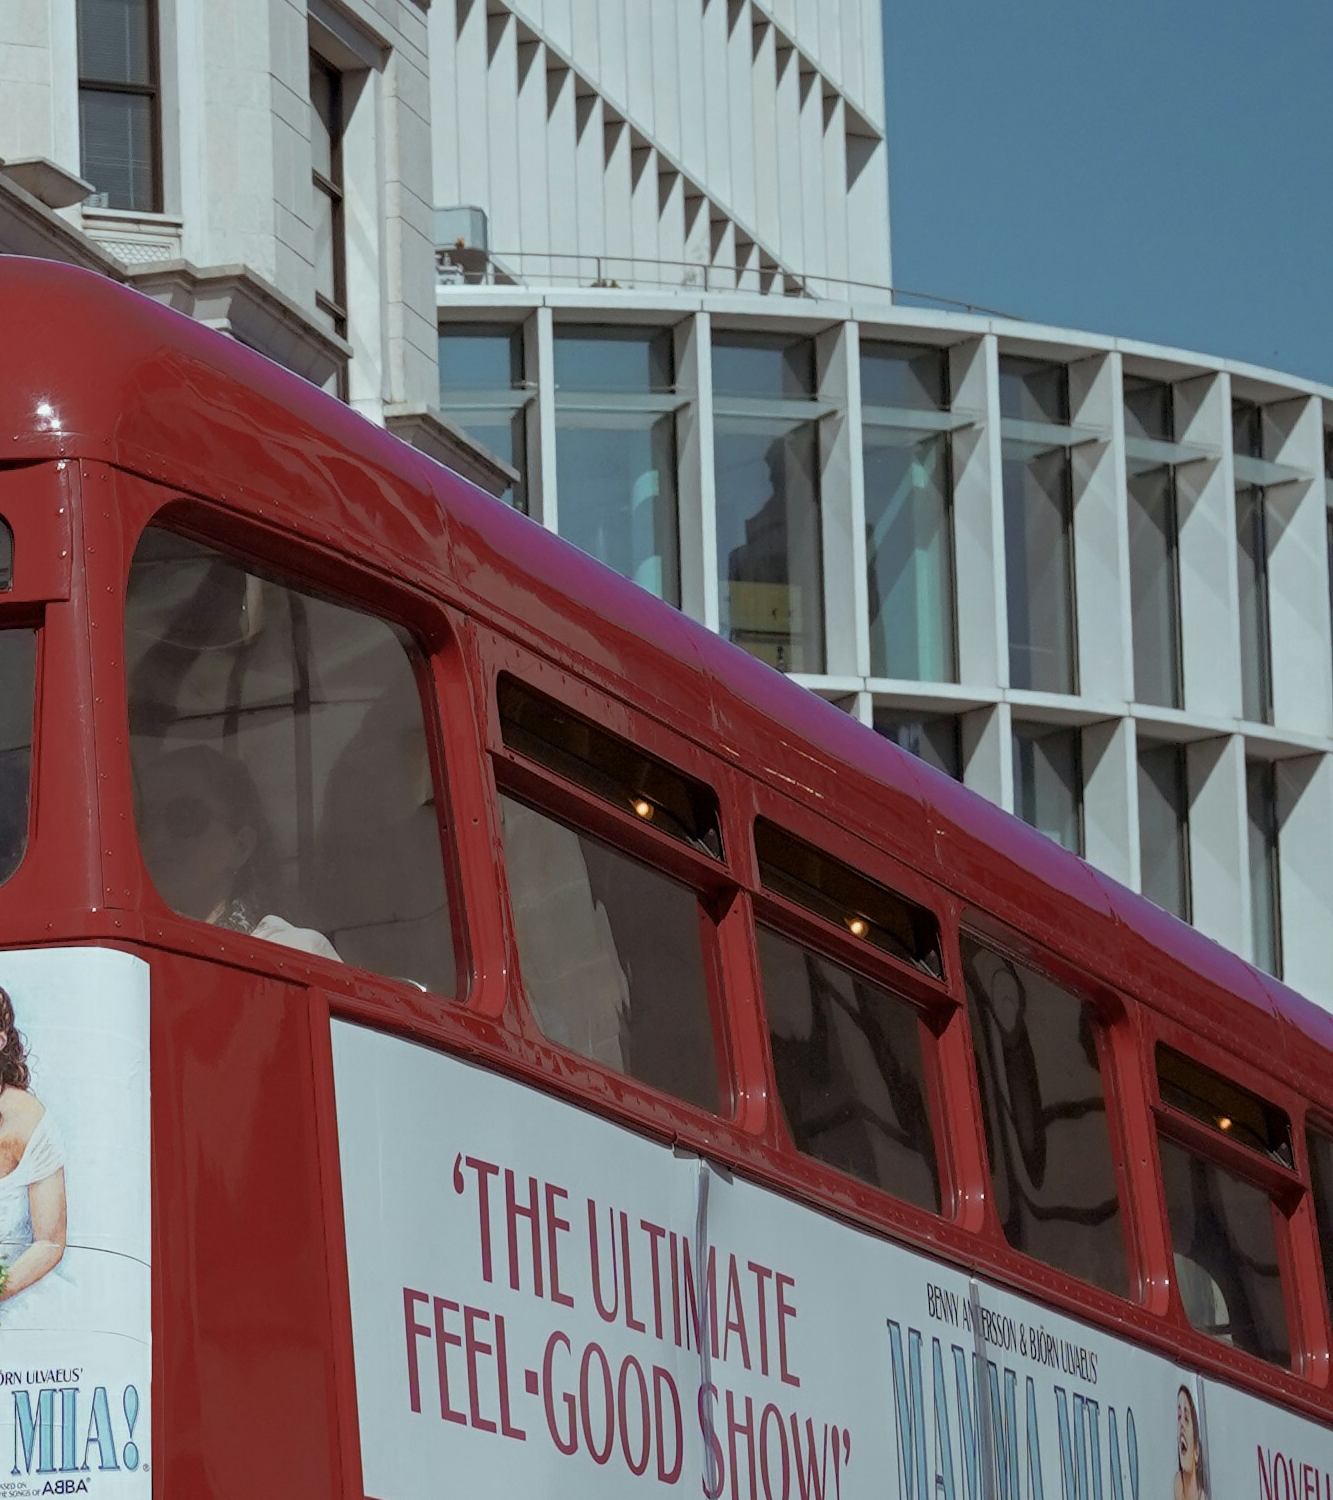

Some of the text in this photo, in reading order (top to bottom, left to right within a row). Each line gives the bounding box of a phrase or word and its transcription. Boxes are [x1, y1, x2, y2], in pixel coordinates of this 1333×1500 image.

[587, 1198, 801, 1389] ULTIMATE
[927, 1283, 960, 1328] BENNY
[1019, 1323, 1028, 1357] &
[1029, 1324, 1060, 1371] BJÖRN
[10, 1384, 140, 1476] MIA!
[403, 1286, 683, 1485] FEEL-GOOD
[42, 1478, 89, 1496] ABBA
